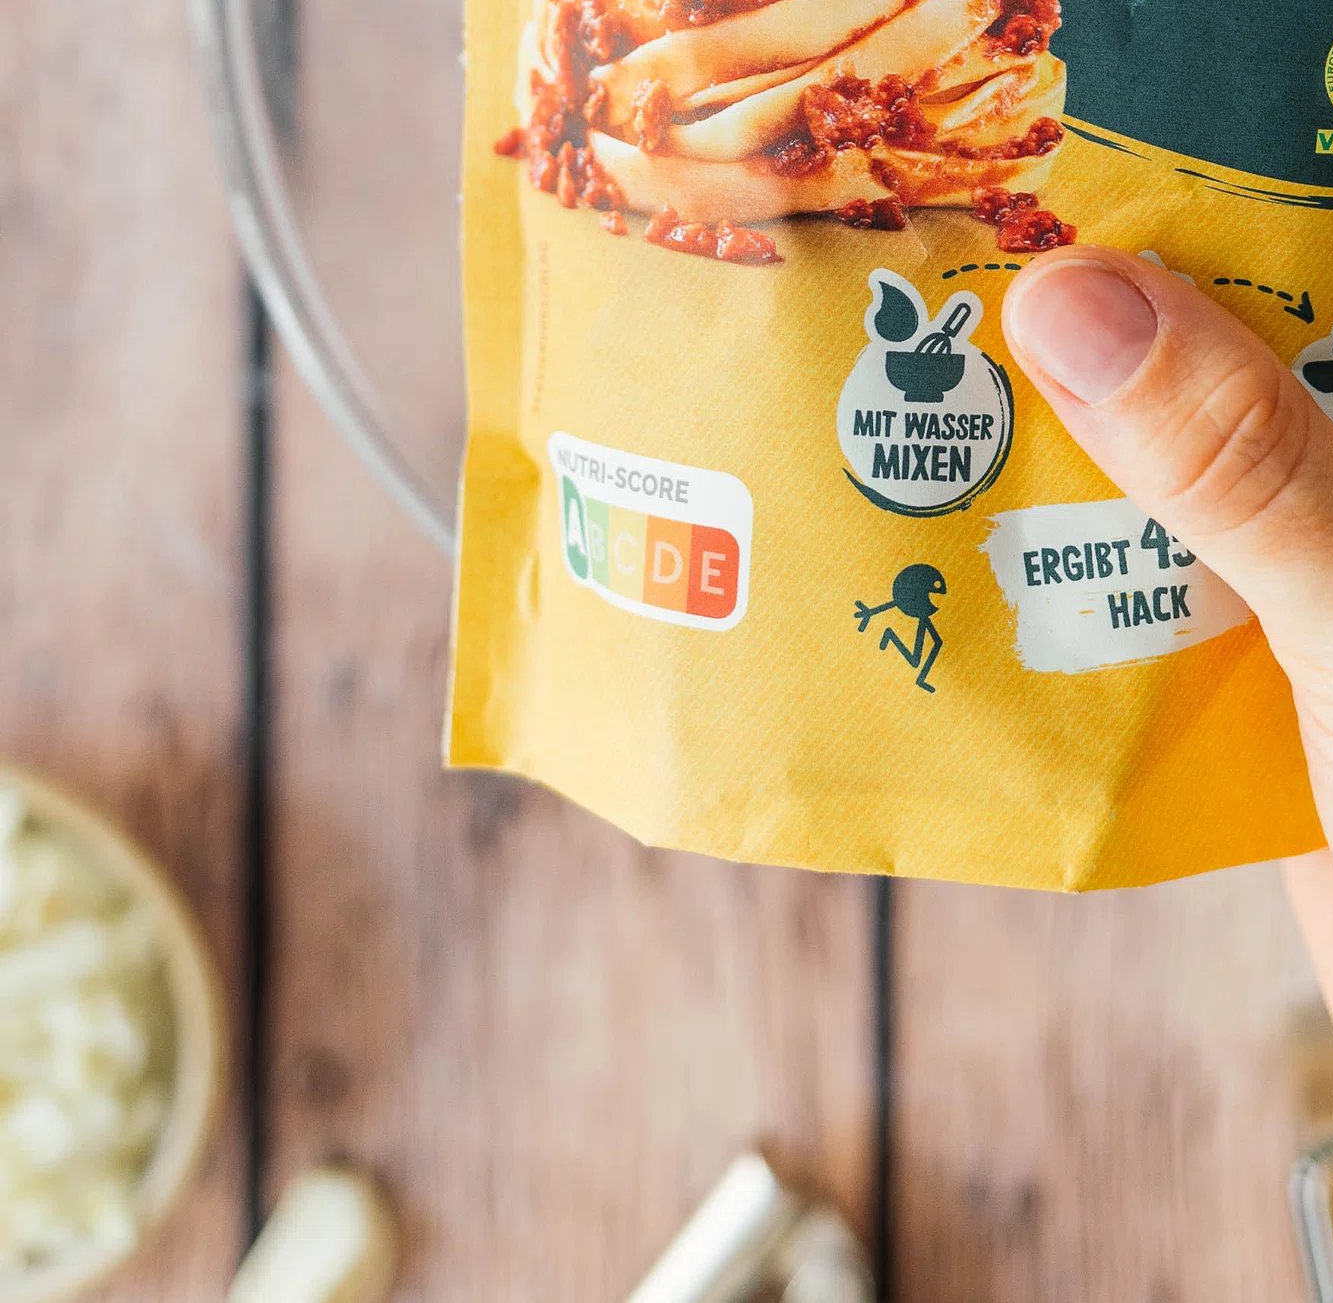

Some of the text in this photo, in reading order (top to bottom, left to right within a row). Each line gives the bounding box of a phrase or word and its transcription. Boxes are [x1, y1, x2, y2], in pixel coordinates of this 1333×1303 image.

[853, 409, 994, 440] MIT WASSER
[557, 448, 690, 504] NUTRI-SCORE
[872, 443, 972, 483] MIXEN
[567, 497, 727, 596] A B C D E
[1023, 539, 1131, 586] ERGIBT
[1107, 584, 1191, 629] HACK
